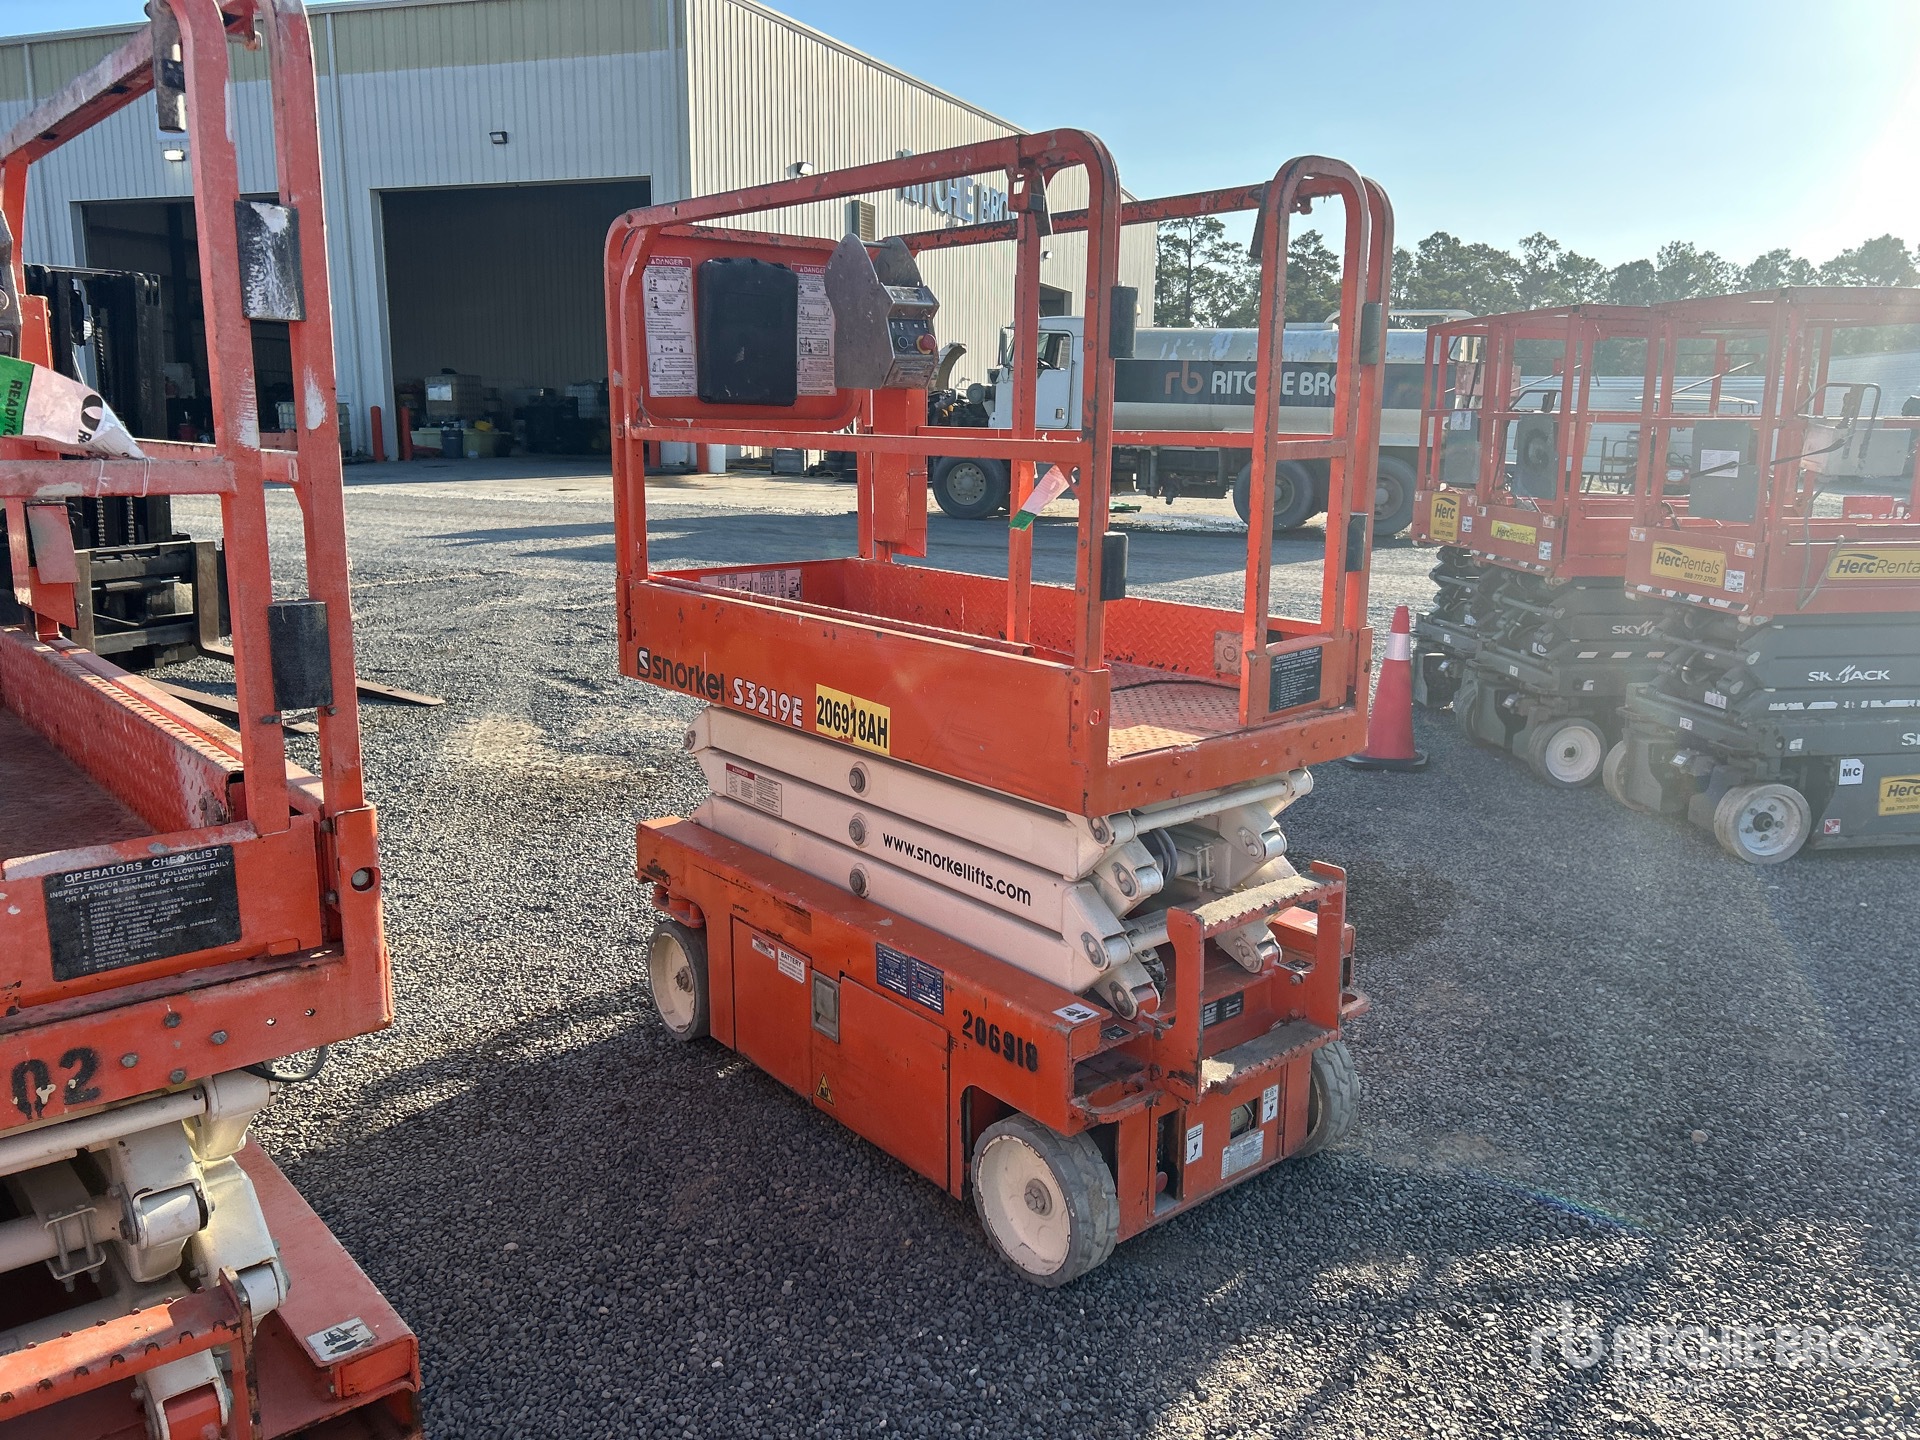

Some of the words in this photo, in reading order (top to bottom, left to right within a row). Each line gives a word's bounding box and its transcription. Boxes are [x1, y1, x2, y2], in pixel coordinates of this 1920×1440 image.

[979, 184, 1016, 224] BRO
[656, 258, 683, 266] DANGER
[1164, 361, 1204, 395] rb
[1211, 371, 1295, 396] RITCE
[1434, 503, 1456, 520] Herc
[1656, 551, 1720, 575] HercRentals
[1611, 621, 1657, 636] SKYJ
[652, 655, 725, 702] snorkel
[732, 677, 803, 729] S3219E
[816, 695, 889, 749] 206918AH
[49, 886, 85, 899] INSPECT
[88, 881, 119, 892] AND/OR
[122, 876, 142, 885] TEST
[144, 872, 160, 880] THE
[163, 864, 207, 878] FOLLOWING
[210, 860, 230, 869] DAILY
[64, 862, 143, 884] OPERATORS
[151, 848, 220, 868] CHECKLIST
[882, 833, 1031, 906] www.snorkellifts.com
[65, 896, 77, 904] OR
[94, 889, 110, 898] THE
[112, 880, 157, 894] BEGINNING
[160, 878, 171, 886] OF
[174, 875, 195, 883] EACH
[197, 869, 218, 879] SHIFT
[780, 951, 802, 967] BATTERY
[961, 1008, 1038, 1072] 206918
